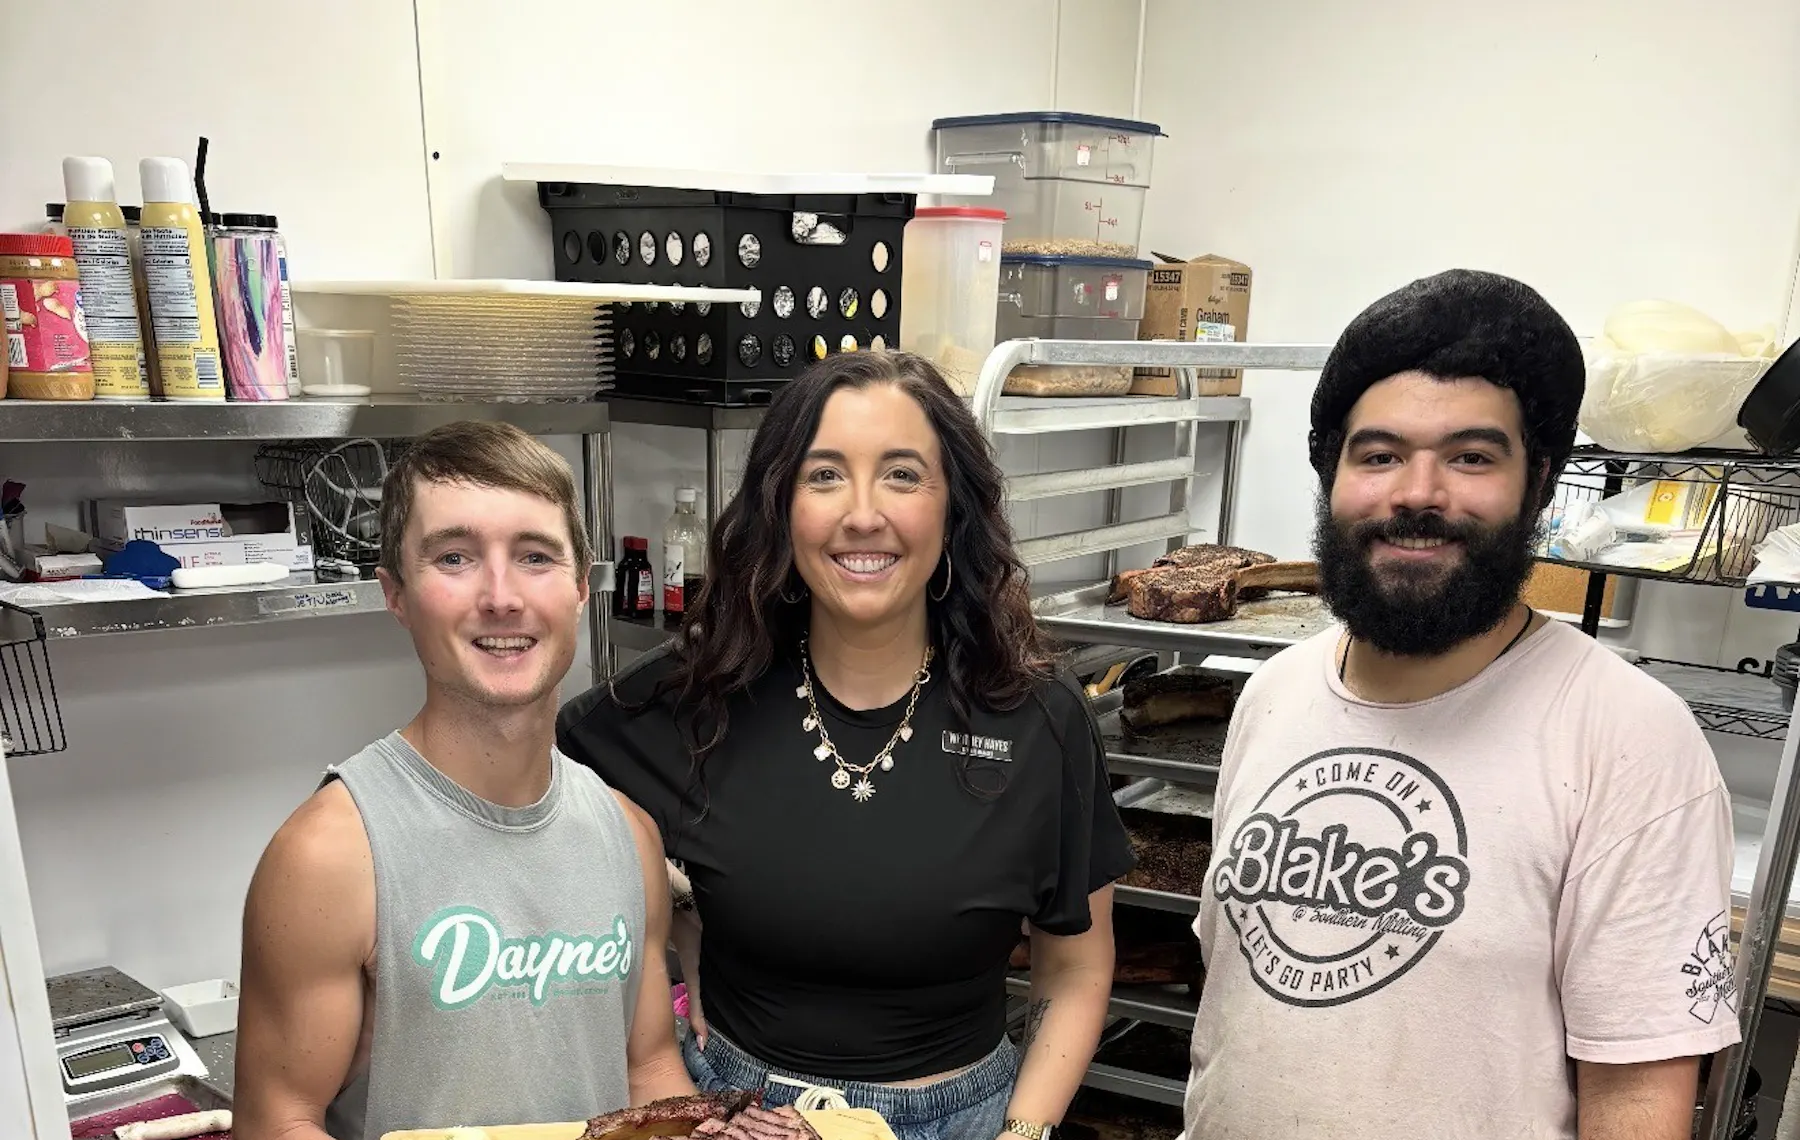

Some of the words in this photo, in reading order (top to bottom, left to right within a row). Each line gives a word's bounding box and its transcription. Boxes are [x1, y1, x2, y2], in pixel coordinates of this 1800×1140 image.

[1154, 270, 1181, 283] 15347
[1196, 308, 1230, 324] Graham
[984, 738, 1009, 753] HAYES
[1315, 762, 1379, 787] COME
[1385, 771, 1420, 801] ON
[1215, 817, 1462, 919] Blake's
[1292, 907, 1306, 922] @
[1309, 904, 1368, 929] Southern
[1371, 912, 1428, 943] Milling
[419, 911, 632, 1005] Dayne's
[1244, 926, 1279, 976] LET'S
[1279, 965, 1303, 991] GO
[1310, 956, 1375, 992] PARTY
[1680, 934, 1729, 976] BLAK
